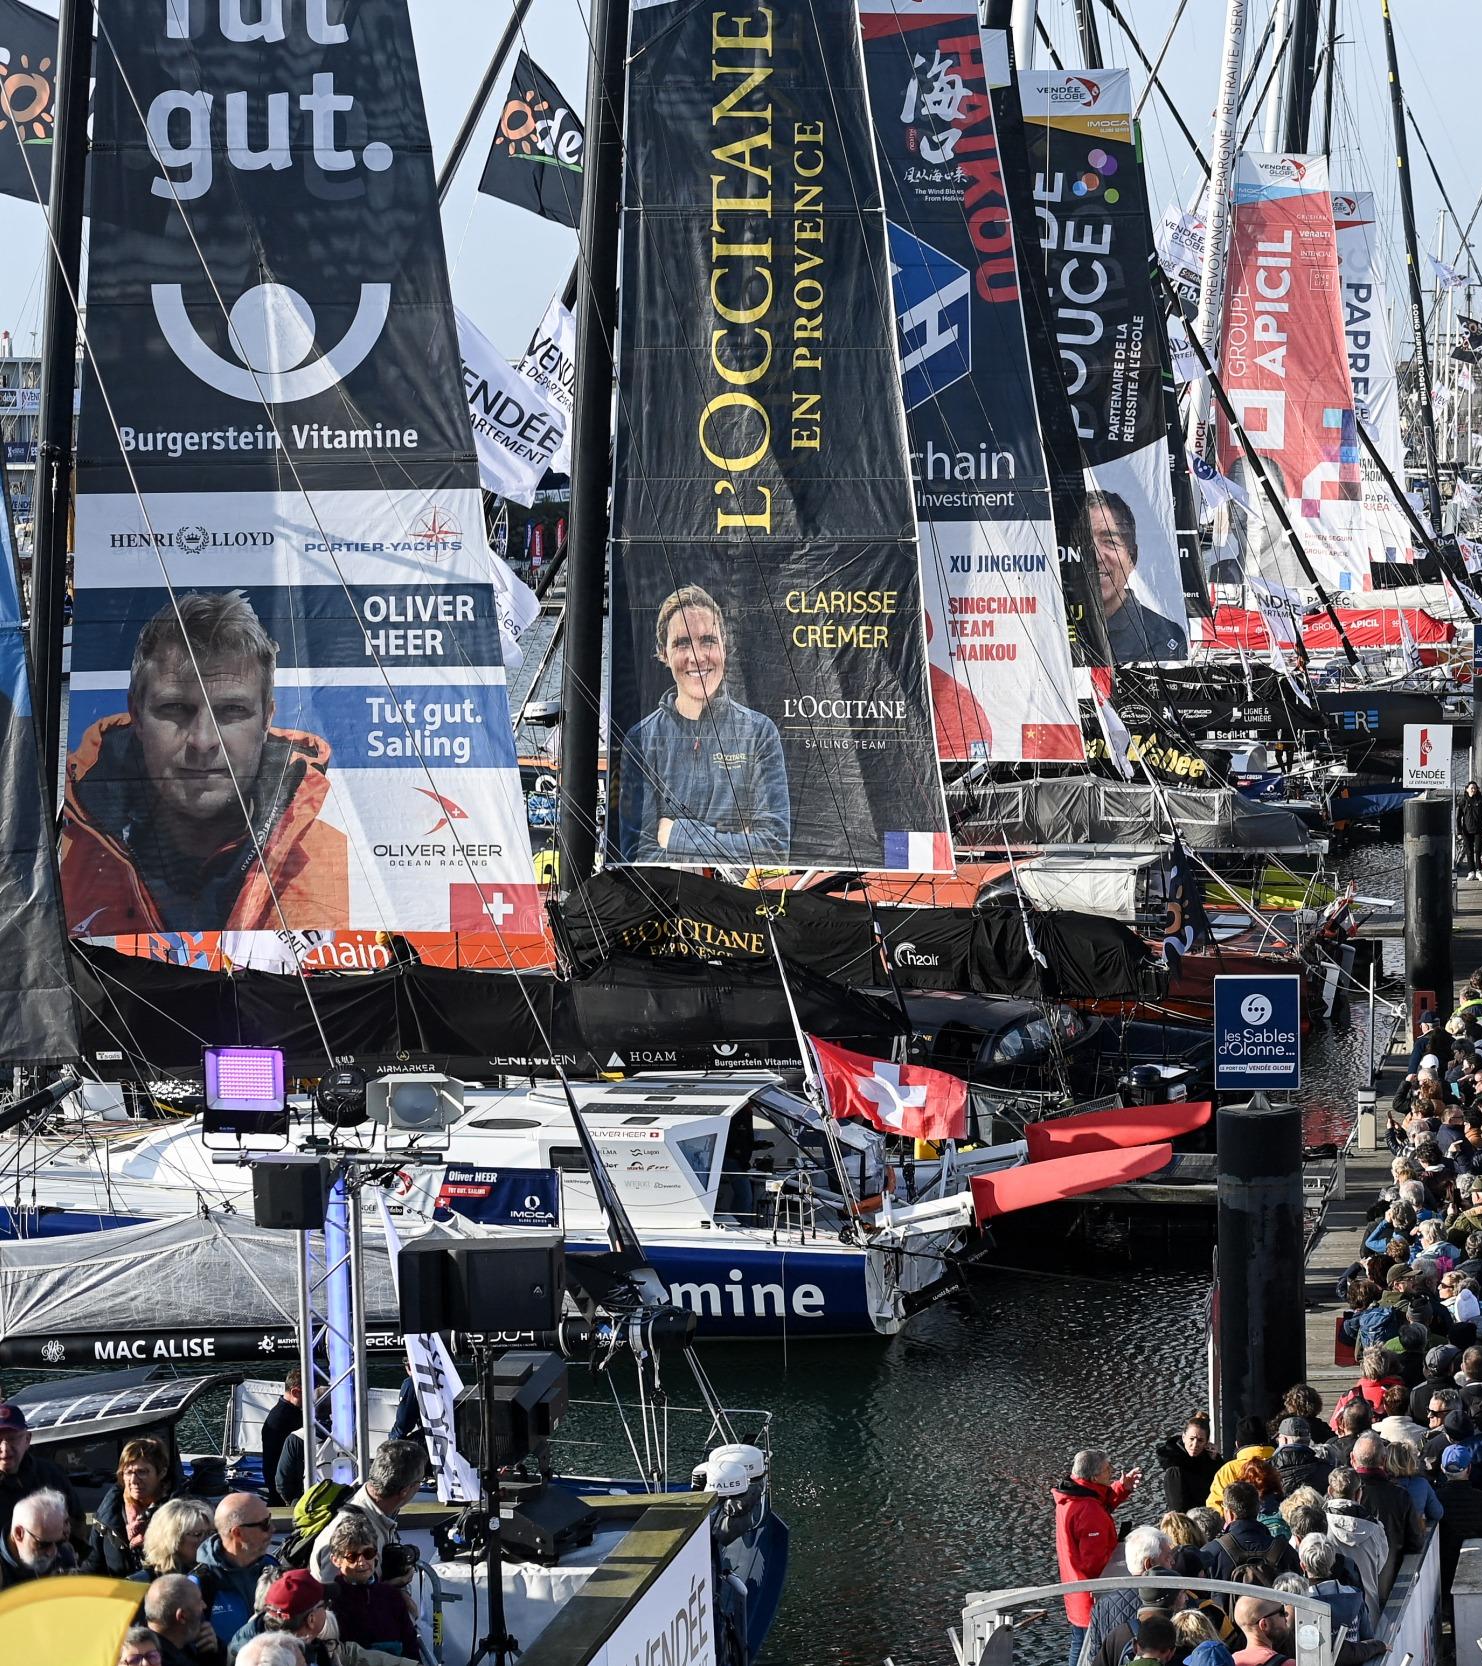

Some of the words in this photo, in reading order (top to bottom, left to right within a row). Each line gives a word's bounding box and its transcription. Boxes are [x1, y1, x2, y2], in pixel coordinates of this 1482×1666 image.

[1222, 55, 1240, 115] RETRAITE
[146, 73, 394, 200] gut.
[936, 33, 1021, 303] HAIKOU
[793, 121, 824, 371] PROVENCE
[699, 7, 774, 534] L'OCCITANE
[1228, 285, 1250, 377] GROUPE
[1253, 229, 1293, 378] APICIL
[1057, 220, 1113, 438] POUCE
[1117, 323, 1129, 339] LA
[1114, 340, 1127, 360] DE
[1128, 315, 1144, 368] L'ÉCOLE
[460, 358, 564, 453] ENDÉE
[1107, 361, 1125, 441] PARTENAIRE
[791, 392, 821, 452] EN
[1123, 384, 1140, 442] RÉUSSITE
[119, 426, 281, 457] Burgerstein
[292, 423, 418, 449] Vitamine
[469, 413, 549, 466] ARTEMENT
[110, 532, 175, 548] HENRI
[212, 530, 274, 547] LLOYD
[303, 541, 464, 553] PORTIER-YACHTS
[950, 554, 973, 572] XU
[977, 554, 1047, 572] JINGKUN
[364, 595, 475, 623] OLIVER
[786, 591, 897, 614] CLARISSE
[948, 597, 1036, 615] SINGCHAIN
[792, 620, 889, 648] CRÉMER
[949, 619, 994, 638] TEAM
[1350, 618, 1380, 629] APICIL
[365, 630, 444, 657] HEER
[366, 697, 416, 724] Tut
[424, 698, 483, 730] gut.
[784, 695, 907, 718] L'OCCITANE
[367, 729, 470, 764] Sailing
[805, 739, 849, 749] SAILING
[855, 740, 886, 749] TEAM
[1409, 767, 1446, 779] VENDÉE
[373, 845, 446, 858] OLIVER
[456, 845, 502, 858] HEER
[906, 951, 940, 966] h2air
[1224, 1028, 1241, 1042] les
[1243, 1028, 1295, 1043] Sables
[630, 1052, 677, 1063] HQAM
[1218, 1041, 1296, 1056] d'Olonne...
[377, 1064, 436, 1073] AIRMARKER
[714, 1059, 763, 1068] Burgerstein
[764, 1058, 802, 1066] Vitamine
[449, 1172, 473, 1182] Oliver
[475, 1172, 498, 1183] HEER
[510, 1211, 555, 1219] IMOCA
[94, 1341, 148, 1360] MAC
[154, 1338, 215, 1358] ALISE
